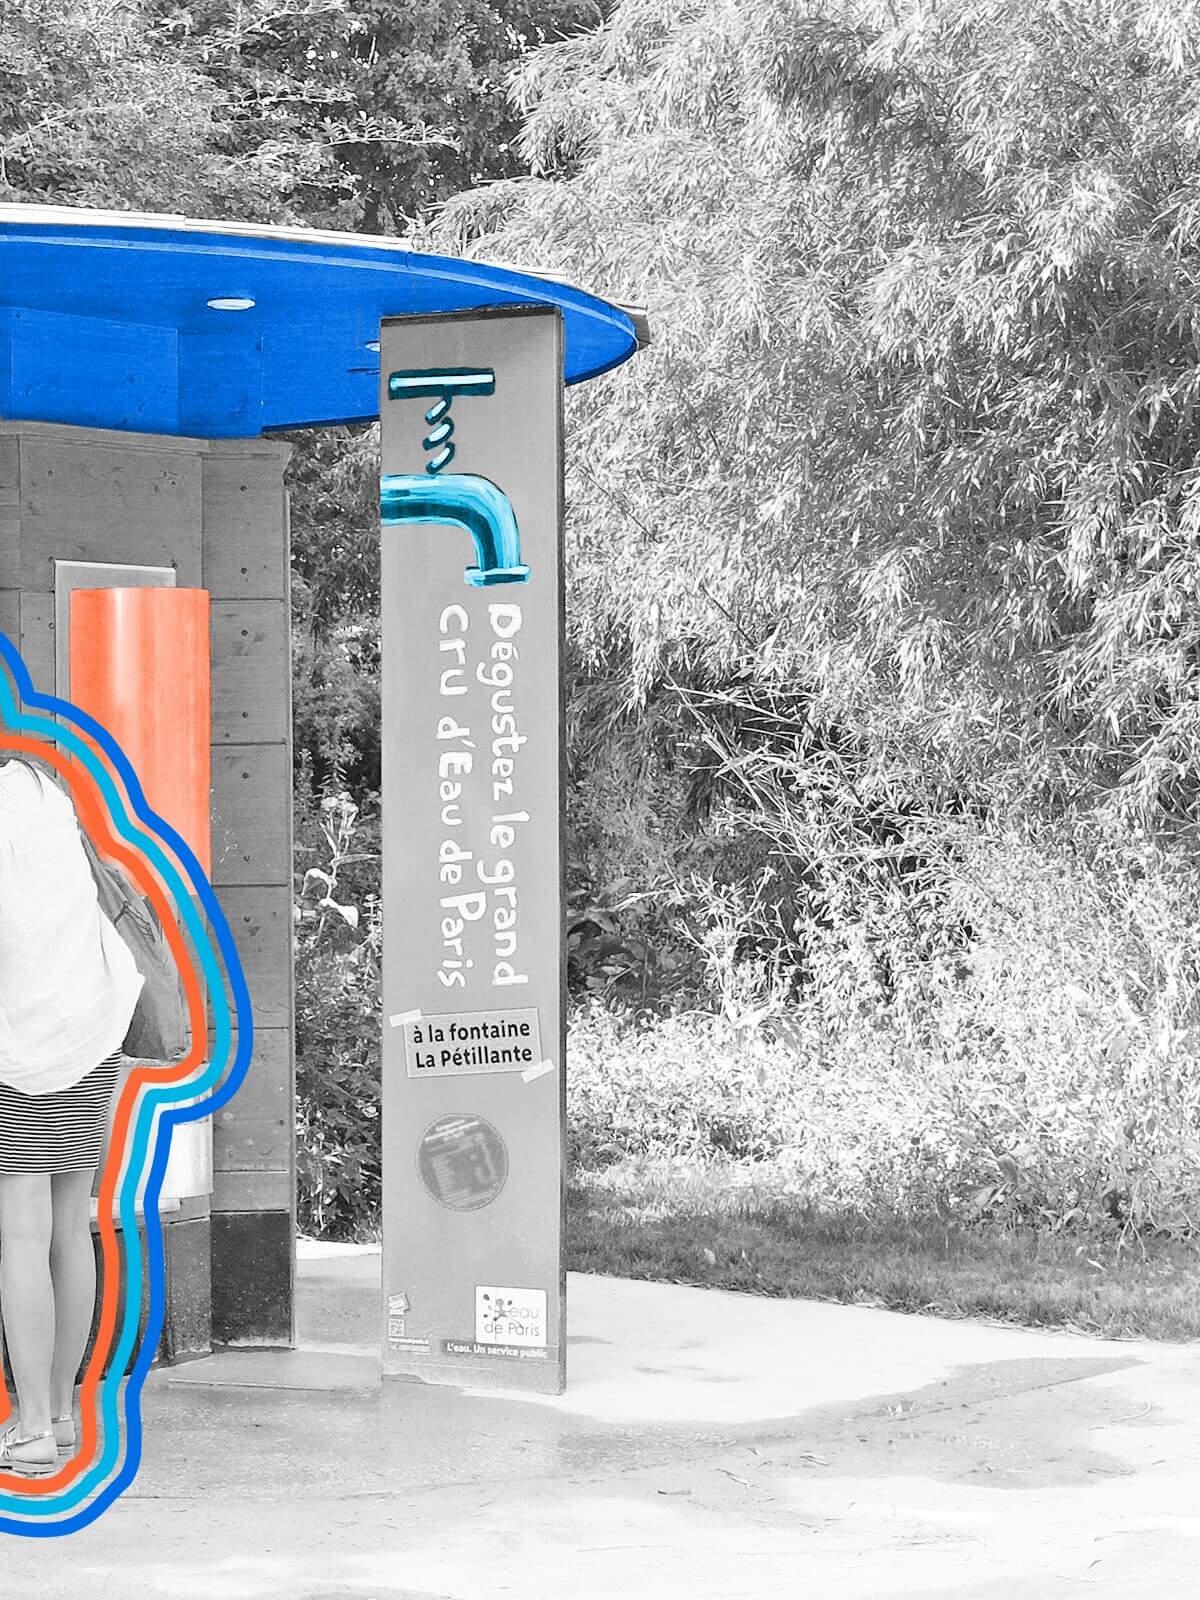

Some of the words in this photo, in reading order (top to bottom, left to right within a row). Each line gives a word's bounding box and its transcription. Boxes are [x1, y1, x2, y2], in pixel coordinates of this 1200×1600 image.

[477, 603, 529, 802] Dégustez
[489, 811, 531, 849] le
[438, 839, 473, 885] de
[477, 858, 529, 986] grand
[437, 890, 487, 988] Paris
[413, 1026, 423, 1043] à
[428, 1025, 444, 1043] la
[449, 1020, 530, 1041] fontaine
[416, 1052, 435, 1068] La
[441, 1046, 532, 1067] Pétillante
[510, 1307, 539, 1319] eau
[484, 1321, 503, 1334] de
[508, 1322, 540, 1337] Paris
[473, 1344, 486, 1354] Un
[487, 1346, 519, 1357] service
[520, 1348, 548, 1359] public
